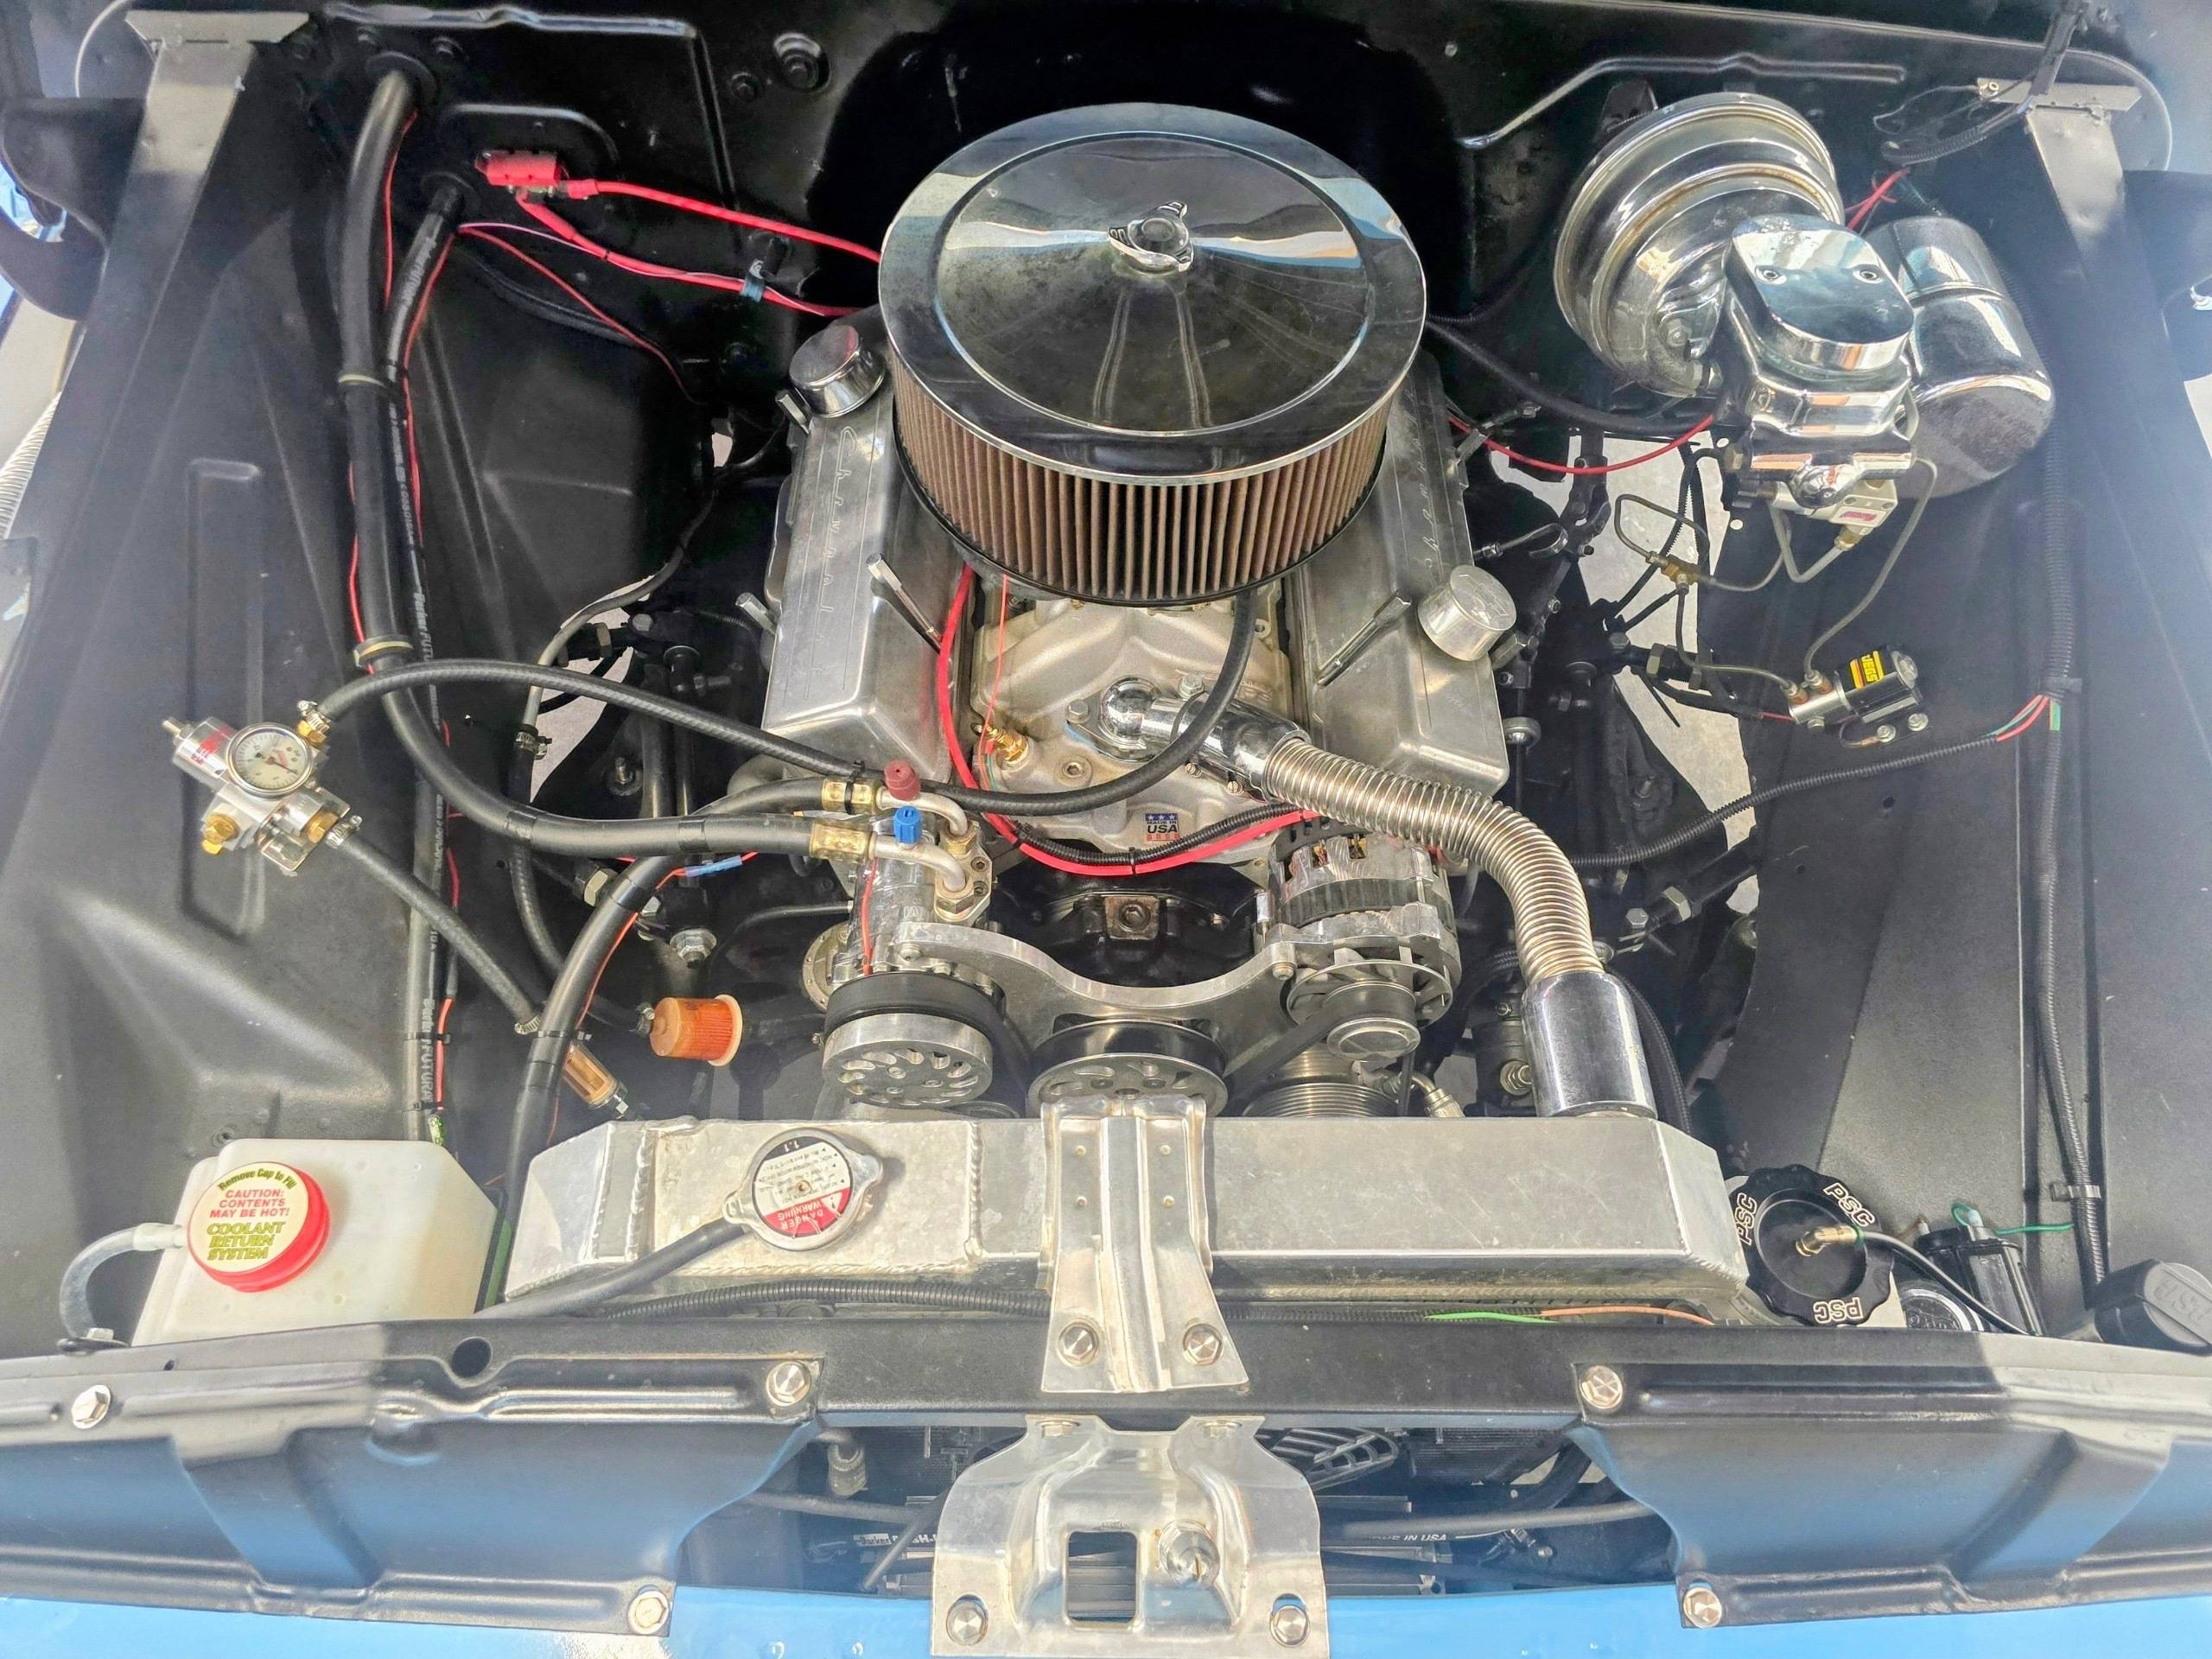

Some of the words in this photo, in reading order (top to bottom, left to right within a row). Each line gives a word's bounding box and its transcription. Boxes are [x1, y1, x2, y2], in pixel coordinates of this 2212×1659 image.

[1861, 654, 1879, 682] JEGS
[1147, 824, 1178, 834] USA
[422, 998, 435, 1044] Parkr
[784, 1141, 800, 1153] 1.1
[218, 1169, 256, 1191] Remove
[257, 1168, 274, 1180] Cap
[275, 1171, 284, 1181] to
[283, 1176, 298, 1191] Fill
[225, 1188, 284, 1198] CAUTION:
[219, 1198, 286, 1208] CONTENTS
[1822, 1182, 1876, 1227] PSC
[209, 1209, 235, 1218] MAY
[239, 1209, 257, 1217] BE
[259, 1208, 290, 1217] HOT!
[780, 1210, 823, 1230] DANGER
[1734, 1192, 1758, 1246] PSC
[207, 1221, 286, 1235] COOLANT
[209, 1235, 275, 1248] RETURN
[207, 1247, 269, 1261] SYSTEM
[1813, 1297, 1864, 1324] PSC
